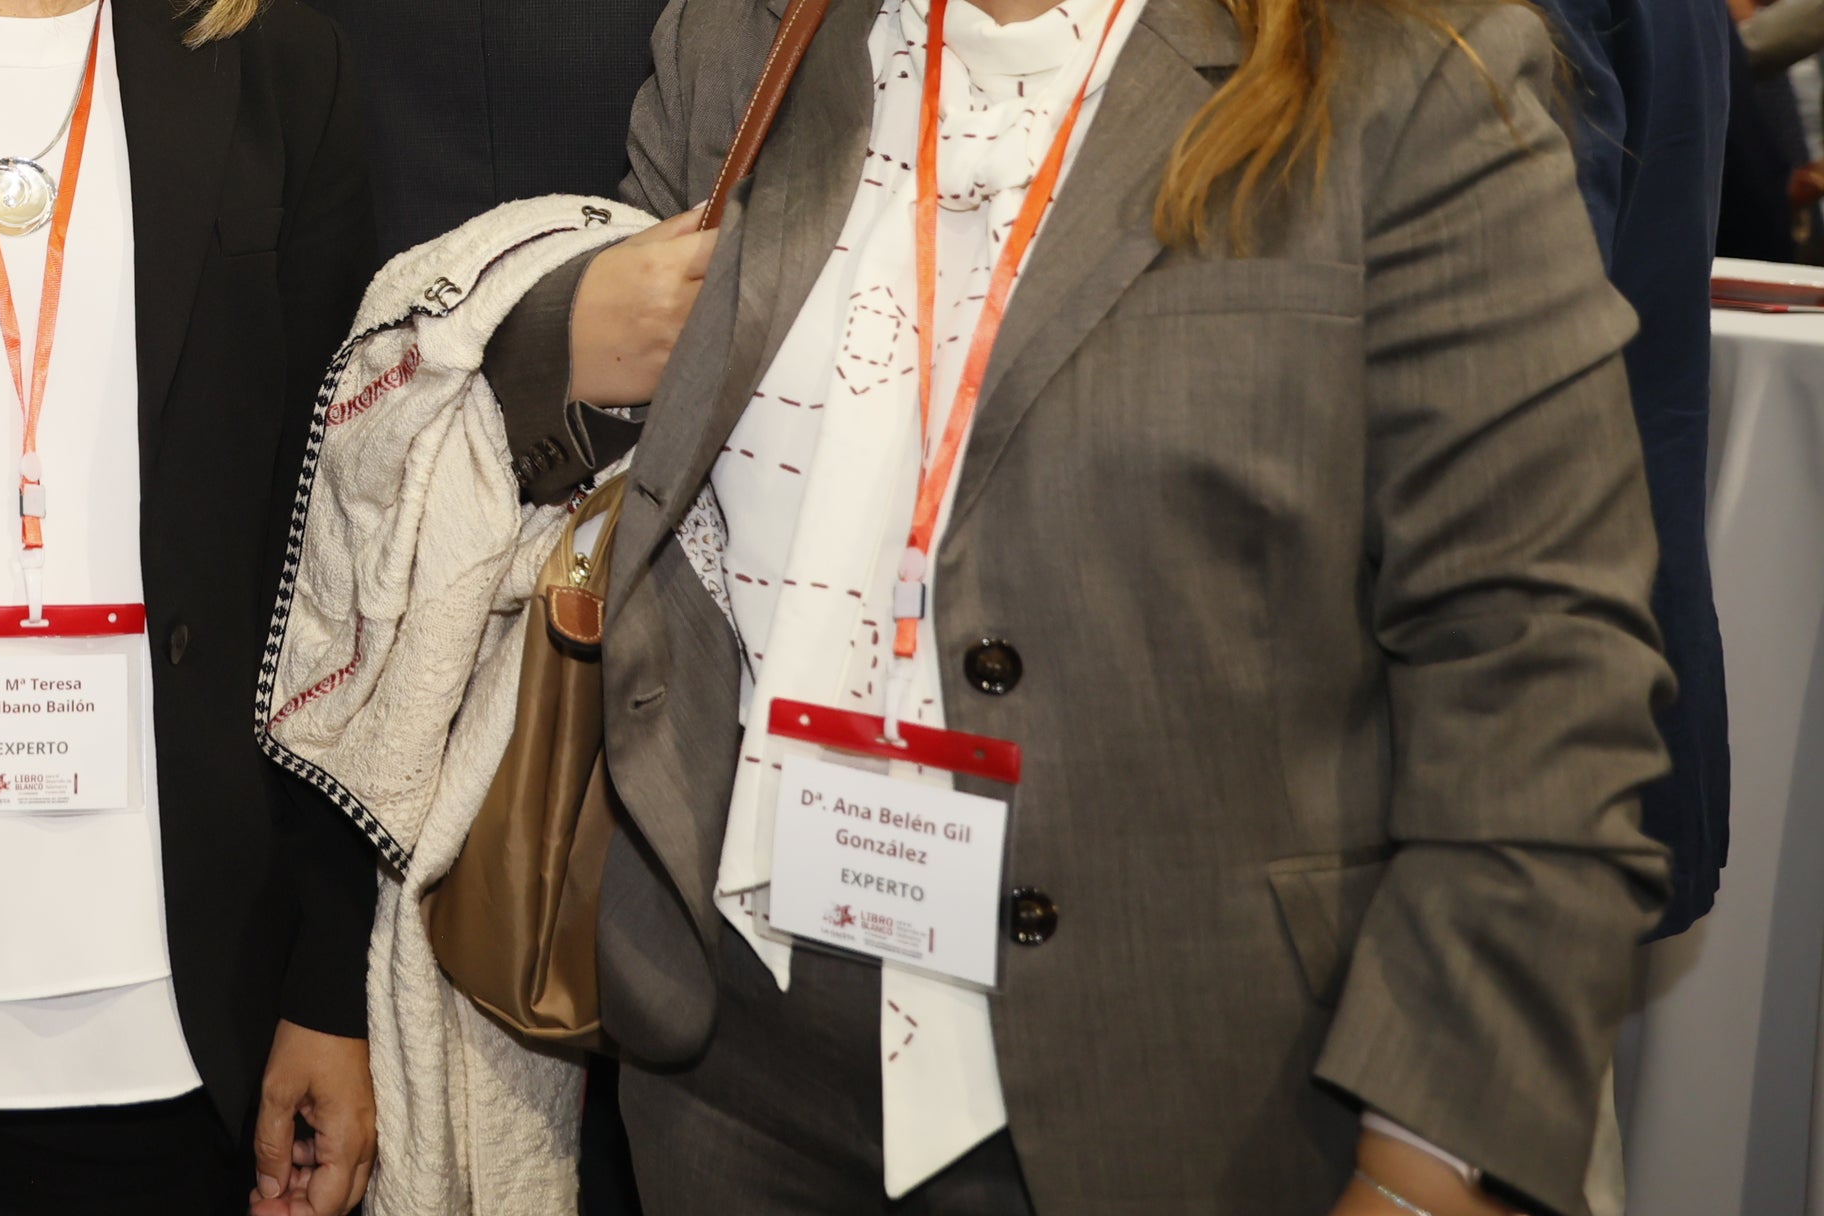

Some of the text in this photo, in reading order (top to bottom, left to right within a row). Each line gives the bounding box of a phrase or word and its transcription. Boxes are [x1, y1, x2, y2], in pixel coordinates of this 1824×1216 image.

[30, 678, 82, 691] Teresa
[46, 699, 95, 713] Bailón
[14, 774, 44, 783] LIBRO
[15, 783, 44, 791] BLANCO
[833, 798, 872, 821] Ana
[879, 807, 936, 836] Belén
[943, 823, 972, 844] Gil
[835, 828, 928, 865] González
[841, 868, 924, 902] EXPERTO
[860, 910, 894, 927] LIBRO
